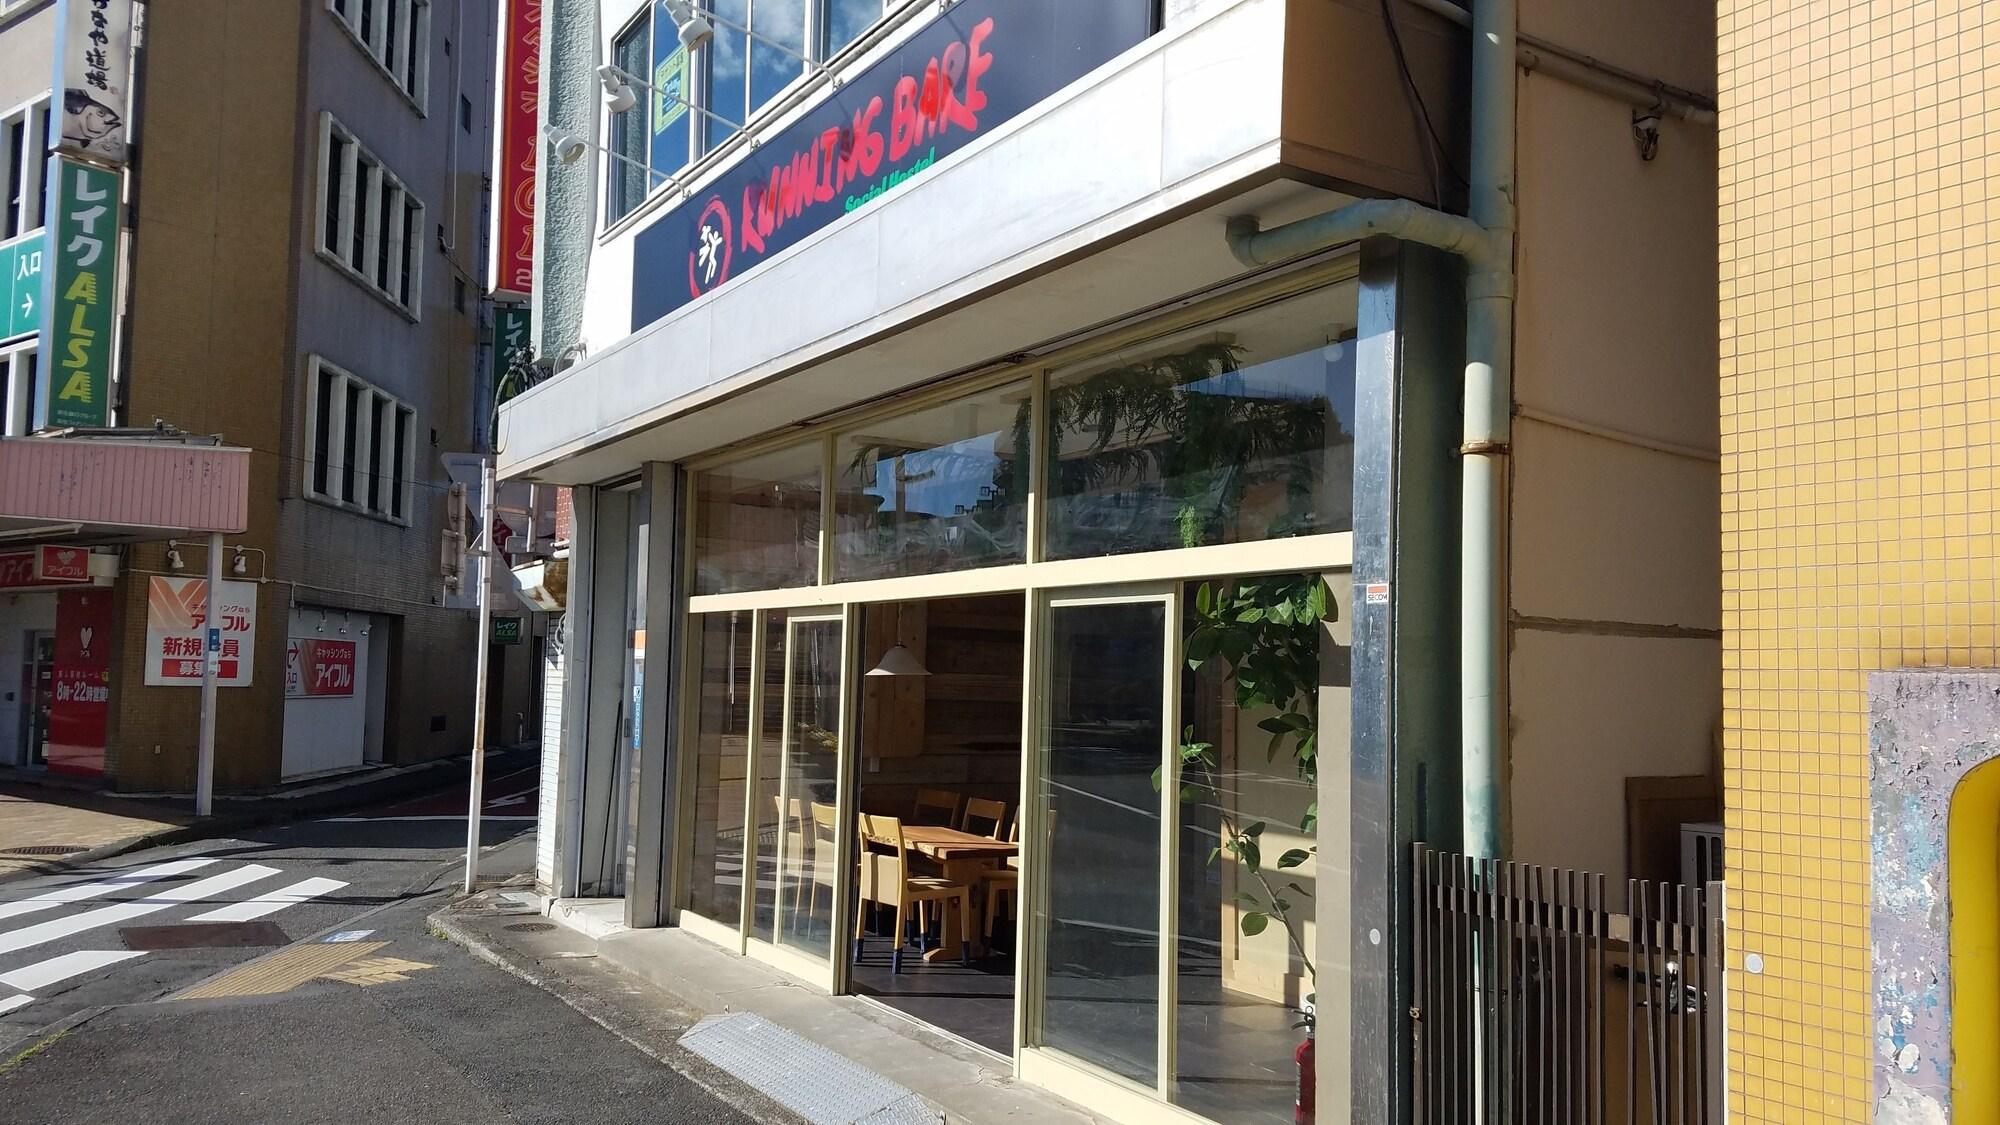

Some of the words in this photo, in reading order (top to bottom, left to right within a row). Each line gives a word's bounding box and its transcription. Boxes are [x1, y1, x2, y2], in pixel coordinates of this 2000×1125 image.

[888, 17, 994, 162] BARE
[845, 175, 888, 214] Social
[17, 251, 42, 281] 入口
[47, 566, 84, 577] アイフル
[1368, 593, 1387, 601] SECOM
[191, 613, 251, 632] アフル
[163, 636, 240, 658] 新規員
[315, 663, 351, 688] アイフル
